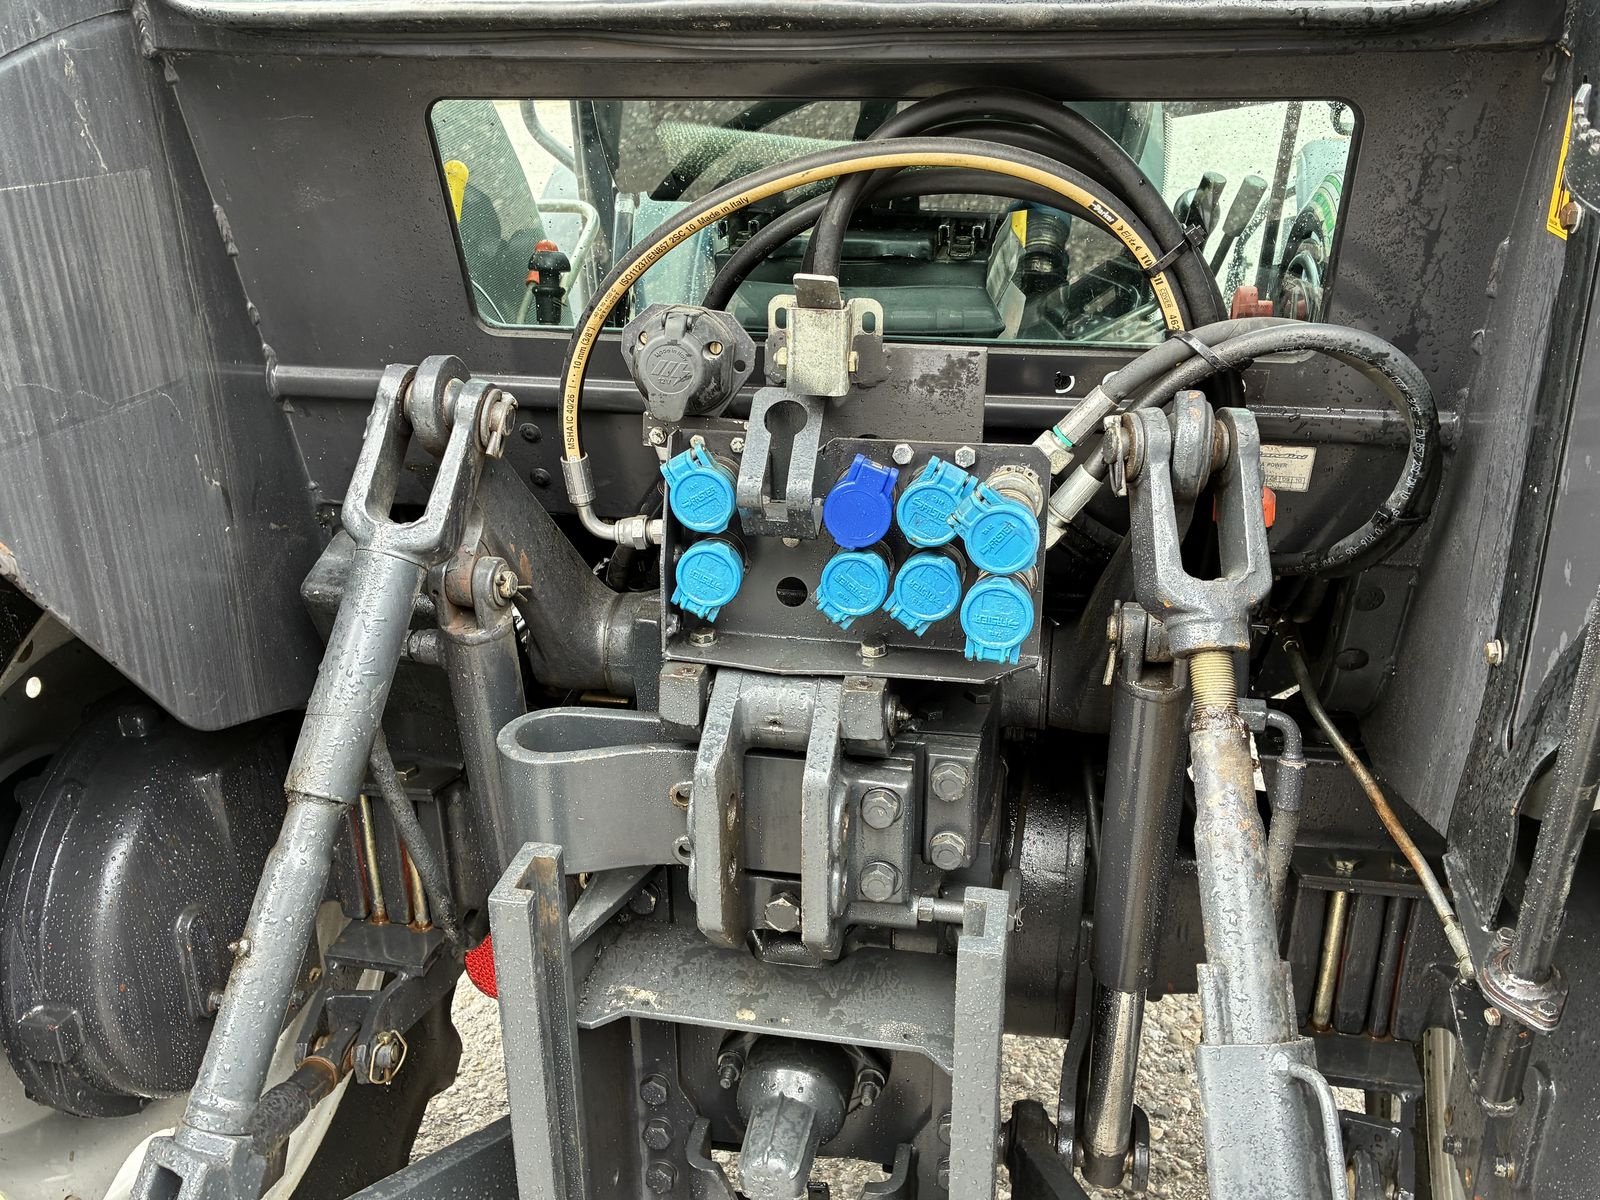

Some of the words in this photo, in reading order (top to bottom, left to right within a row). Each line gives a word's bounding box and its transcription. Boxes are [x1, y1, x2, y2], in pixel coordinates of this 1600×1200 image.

[730, 196, 750, 209] Italy
[720, 206, 730, 215] in
[697, 210, 721, 226] Made
[685, 223, 697, 233] 10
[669, 230, 686, 244] 2SC
[1093, 202, 1115, 223] Parker
[1160, 287, 1174, 309] COVER
[577, 346, 587, 361] mm
[573, 360, 582, 369] 10
[566, 393, 575, 415] 40/26
[566, 415, 574, 425] IC
[567, 425, 576, 450] MSHA
[1415, 428, 1426, 440] EN
[1414, 442, 1425, 458] 857
[1410, 458, 1423, 475] 2SC
[1405, 475, 1417, 488] DN
[1400, 490, 1411, 499] 10
[1360, 533, 1377, 547] R16
